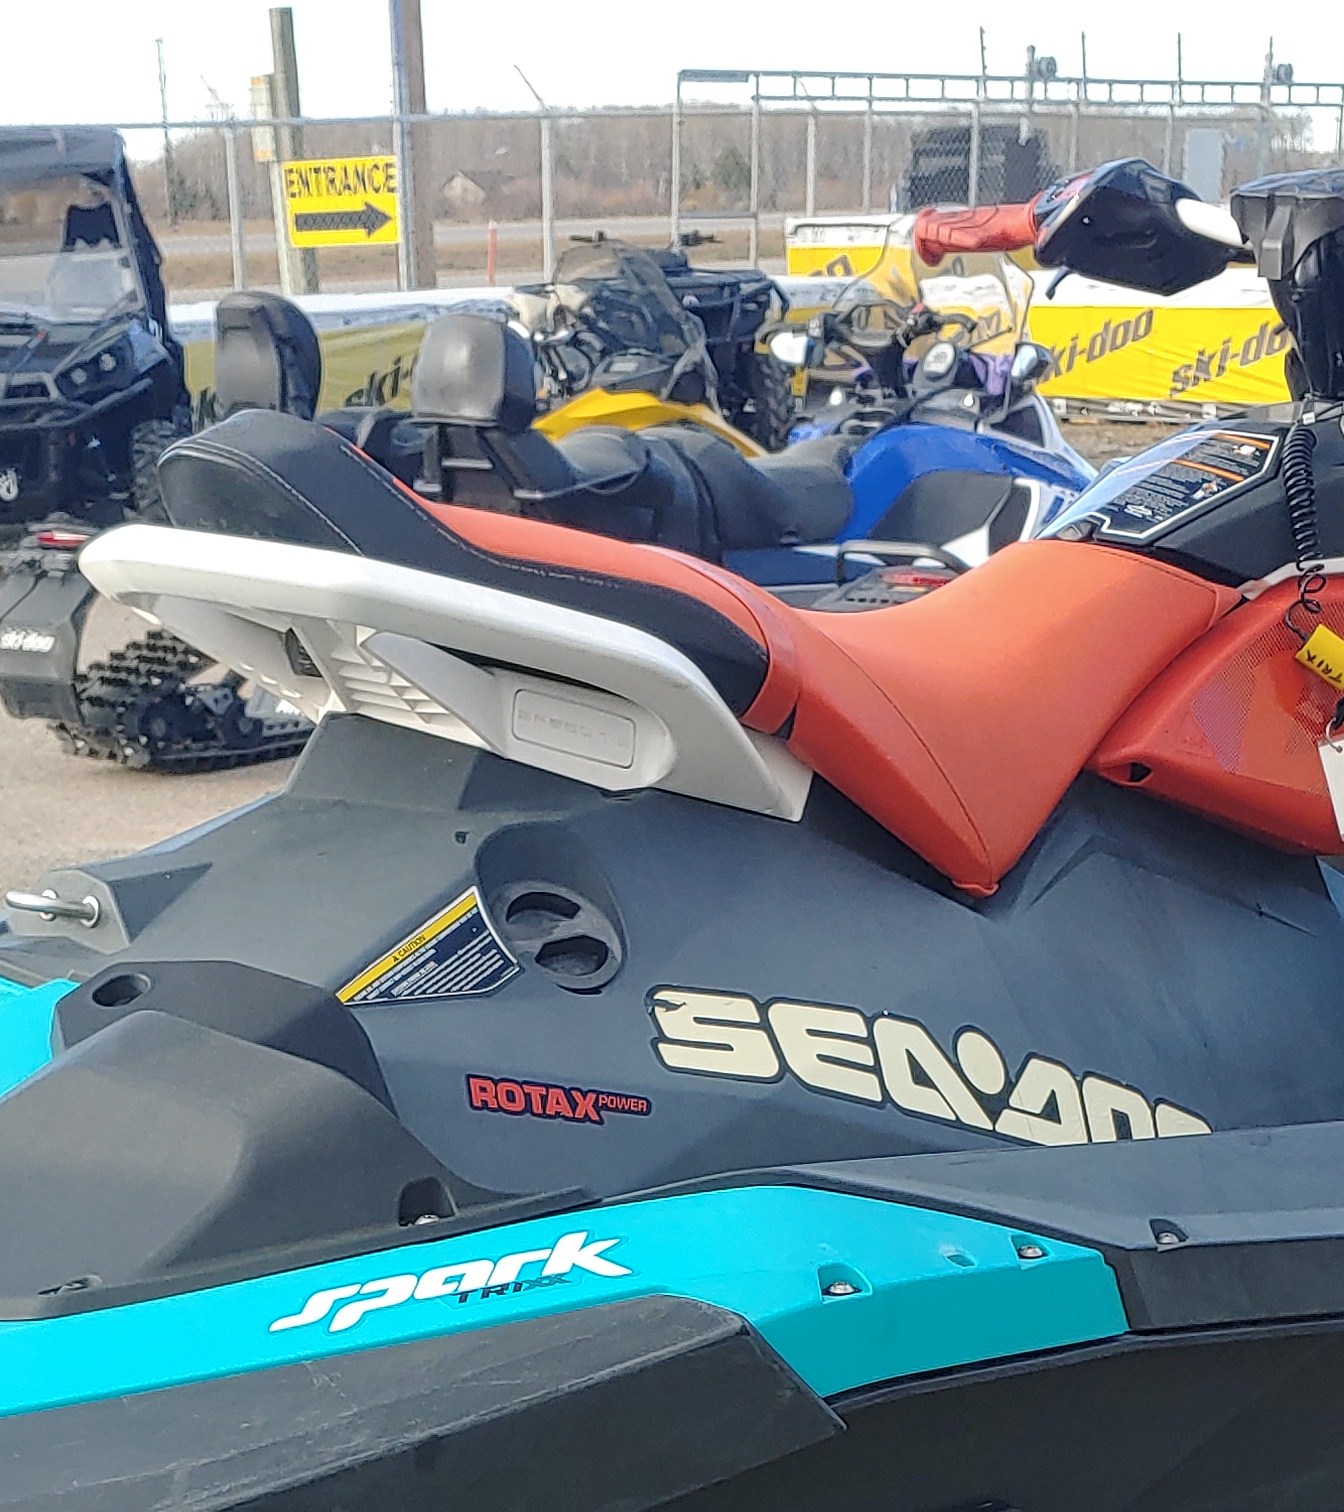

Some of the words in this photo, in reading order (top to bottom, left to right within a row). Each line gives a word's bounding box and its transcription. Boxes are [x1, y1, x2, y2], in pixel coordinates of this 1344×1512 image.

[285, 162, 396, 198] ENTRANCE
[1169, 319, 1290, 398] ski-do
[398, 934, 426, 957] CAUTION
[468, 1076, 602, 1122] ROTAX
[598, 1094, 648, 1113] POWER
[268, 1231, 633, 1333] spark
[454, 1273, 572, 1305] TRIXX
